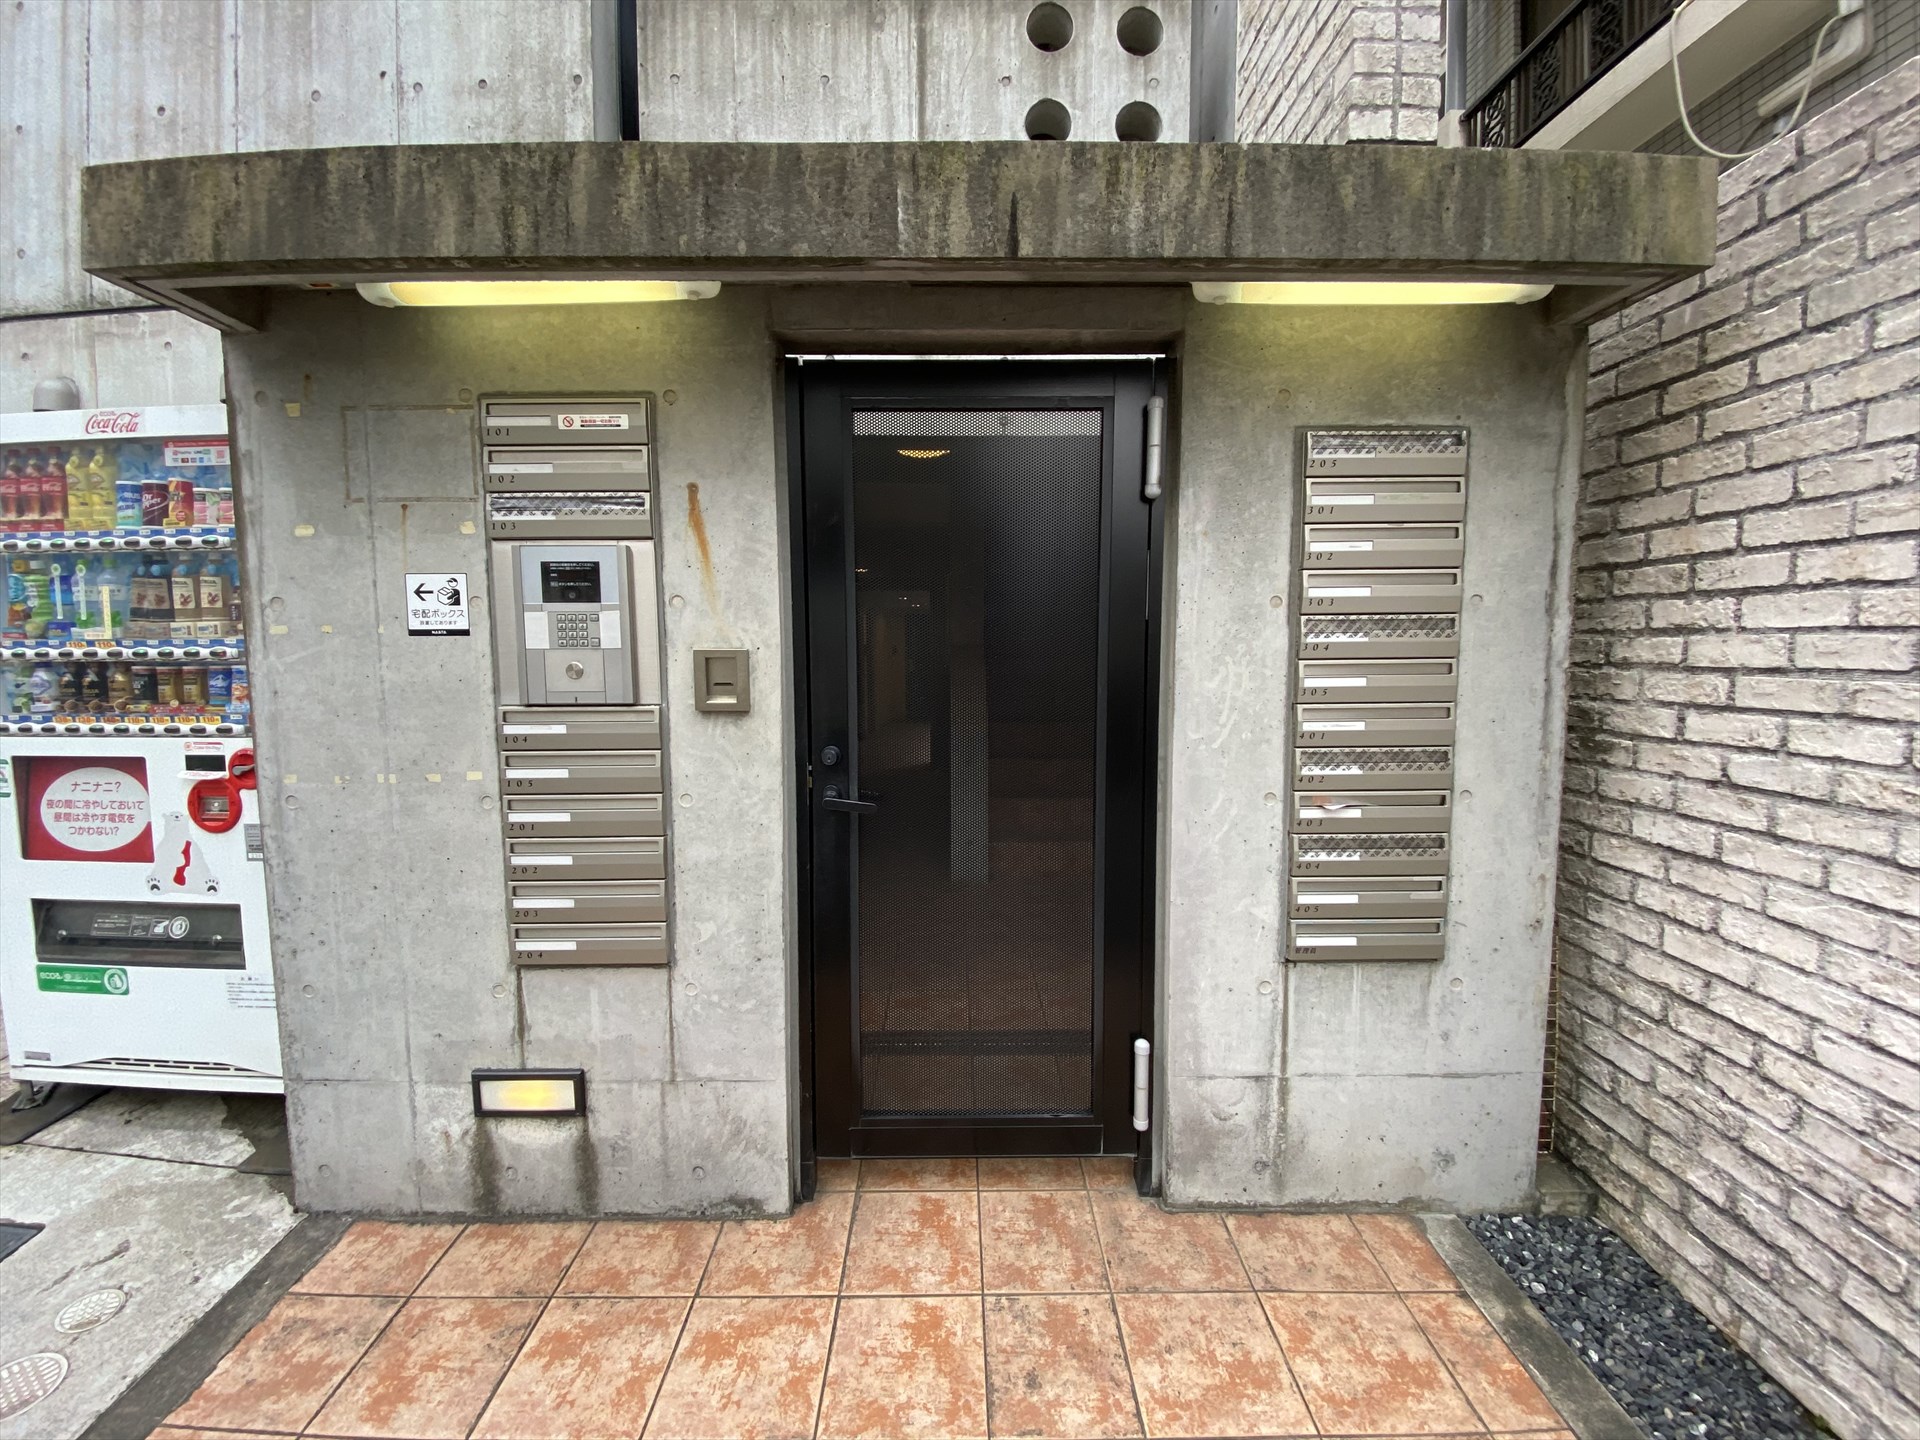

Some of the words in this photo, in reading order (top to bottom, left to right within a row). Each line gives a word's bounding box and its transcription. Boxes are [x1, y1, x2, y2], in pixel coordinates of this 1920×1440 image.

[85, 412, 141, 435] Coca-Cola
[486, 427, 511, 437] 101
[1309, 459, 1337, 468] 205
[488, 475, 516, 484] 102
[1307, 506, 1335, 515] 301
[491, 522, 517, 531] 103
[1306, 552, 1334, 561] 302
[1307, 598, 1334, 607] 303
[411, 608, 466, 619] 宅配ボックス
[1302, 643, 1330, 652] 304
[1301, 688, 1328, 697] 305
[504, 735, 528, 744] 104
[1299, 732, 1326, 741] 401
[507, 779, 533, 788] 105
[1298, 775, 1325, 784] 402
[70, 781, 122, 793] ナニナニ?
[46, 799, 146, 811] 夜の間に冷やしておいて
[53, 812, 136, 824] 昼間は冷やす電気を
[1296, 818, 1323, 827] 403
[68, 826, 120, 836] つかわない?
[509, 823, 536, 832] 201
[511, 866, 538, 875] 202
[1296, 862, 1321, 870] 404
[1295, 905, 1319, 913] 405
[514, 910, 539, 918] 203
[517, 951, 543, 960] 204
